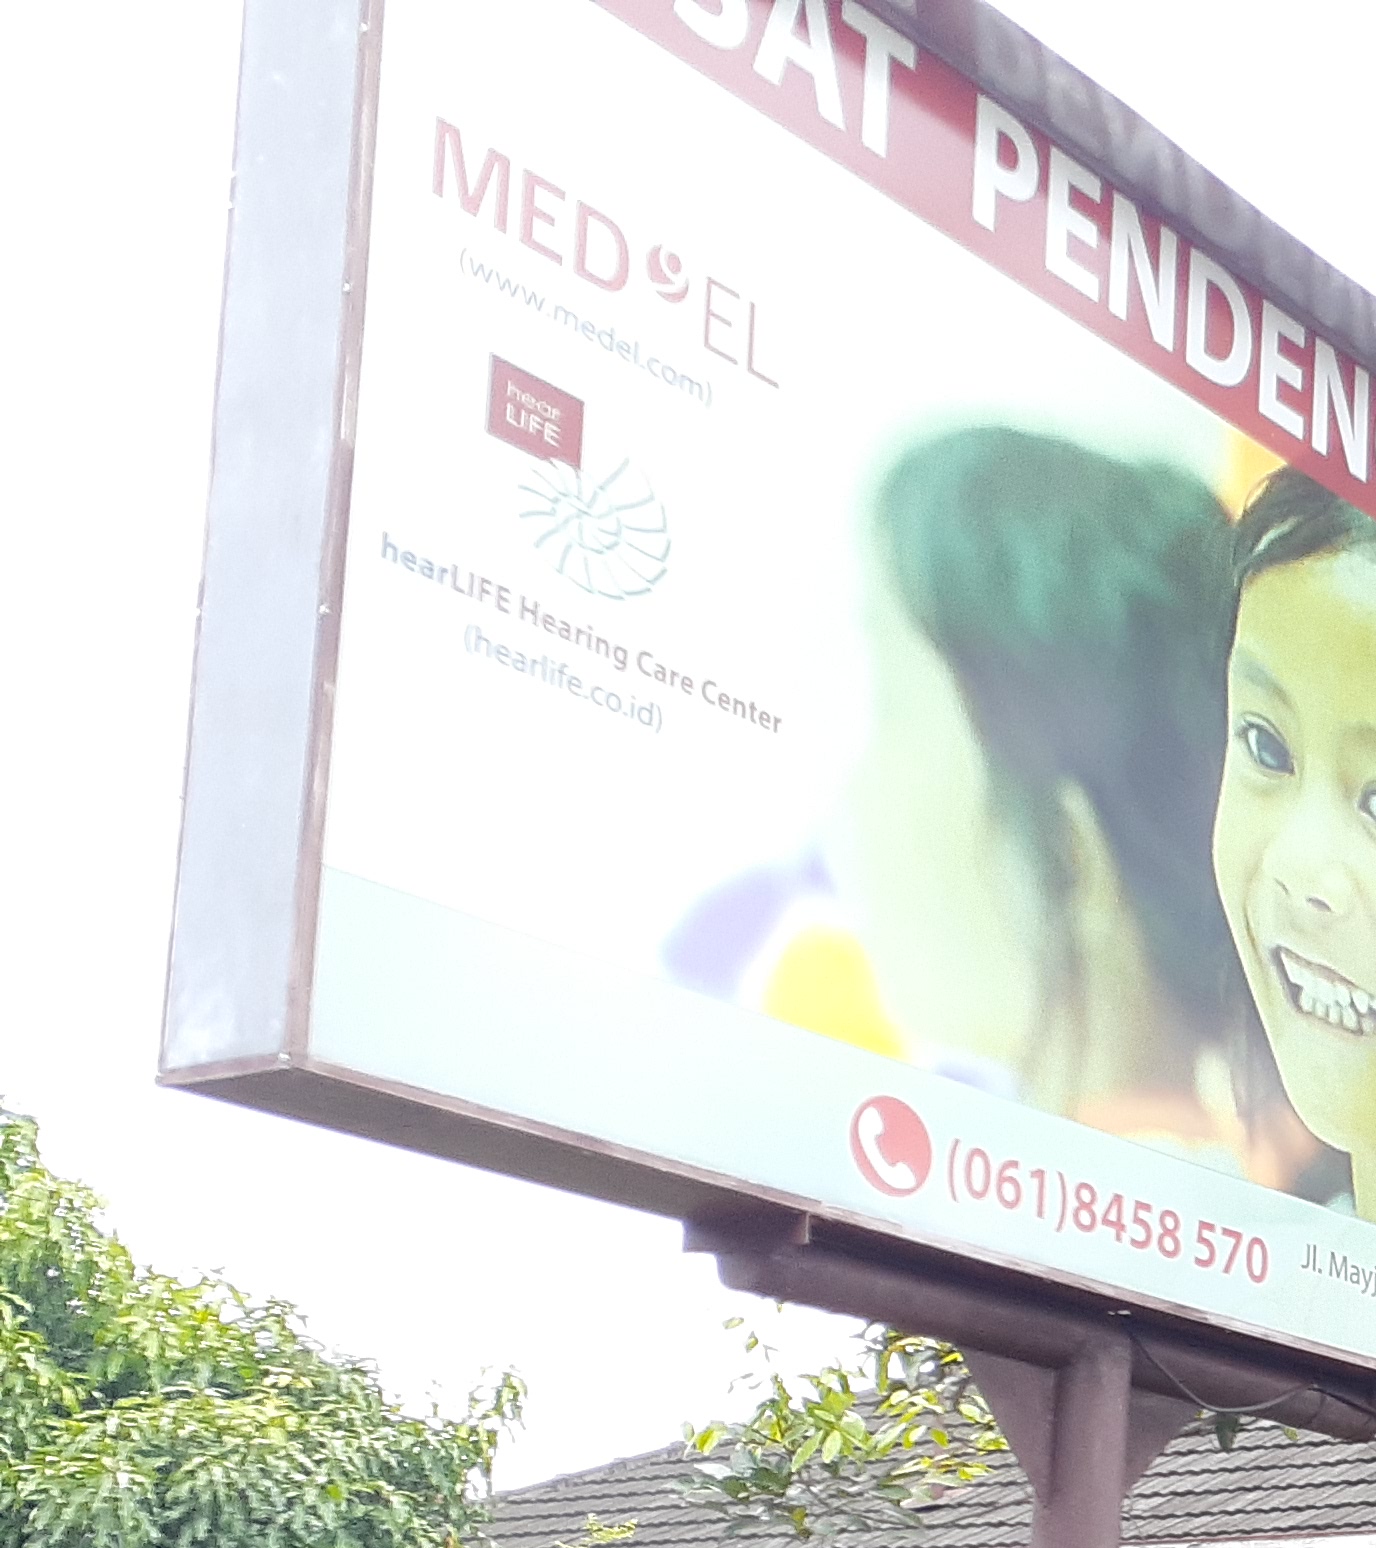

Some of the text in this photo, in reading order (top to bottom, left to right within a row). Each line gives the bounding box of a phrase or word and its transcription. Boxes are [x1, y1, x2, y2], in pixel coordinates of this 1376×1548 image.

[459, 247, 713, 407] (www.medel.com)
[505, 401, 562, 448] LIFE
[381, 531, 784, 734] hearLIFE Hearing Care Center
[463, 623, 664, 735] (hearlife.co.id)
[948, 1138, 1270, 1285] (061)8458 570
[1301, 1243, 1323, 1275] Jl.
